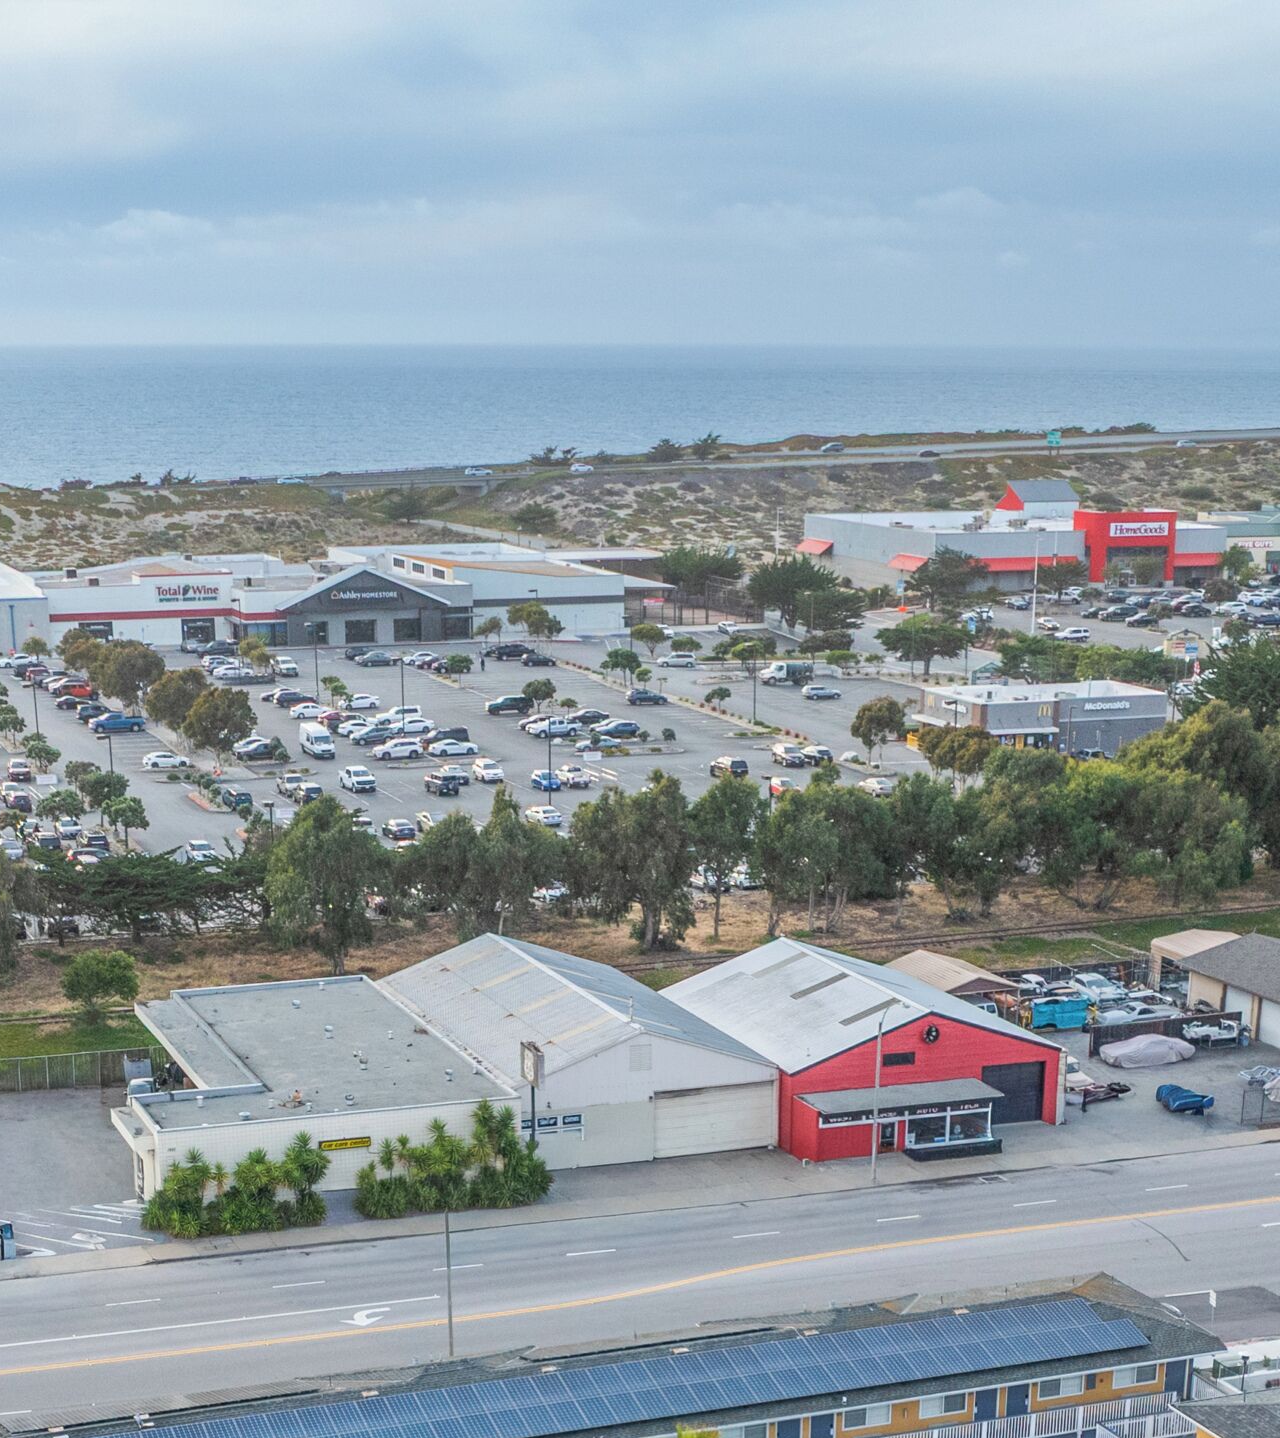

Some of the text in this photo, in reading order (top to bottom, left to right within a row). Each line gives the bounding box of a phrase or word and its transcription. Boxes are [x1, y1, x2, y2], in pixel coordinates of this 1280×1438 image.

[1114, 524, 1166, 536] HomeGoods
[155, 585, 219, 597] Total Wine
[338, 590, 397, 600] Ashley HOMESTORE
[1084, 701, 1130, 711] McDonald's
[350, 1138, 370, 1147] center
